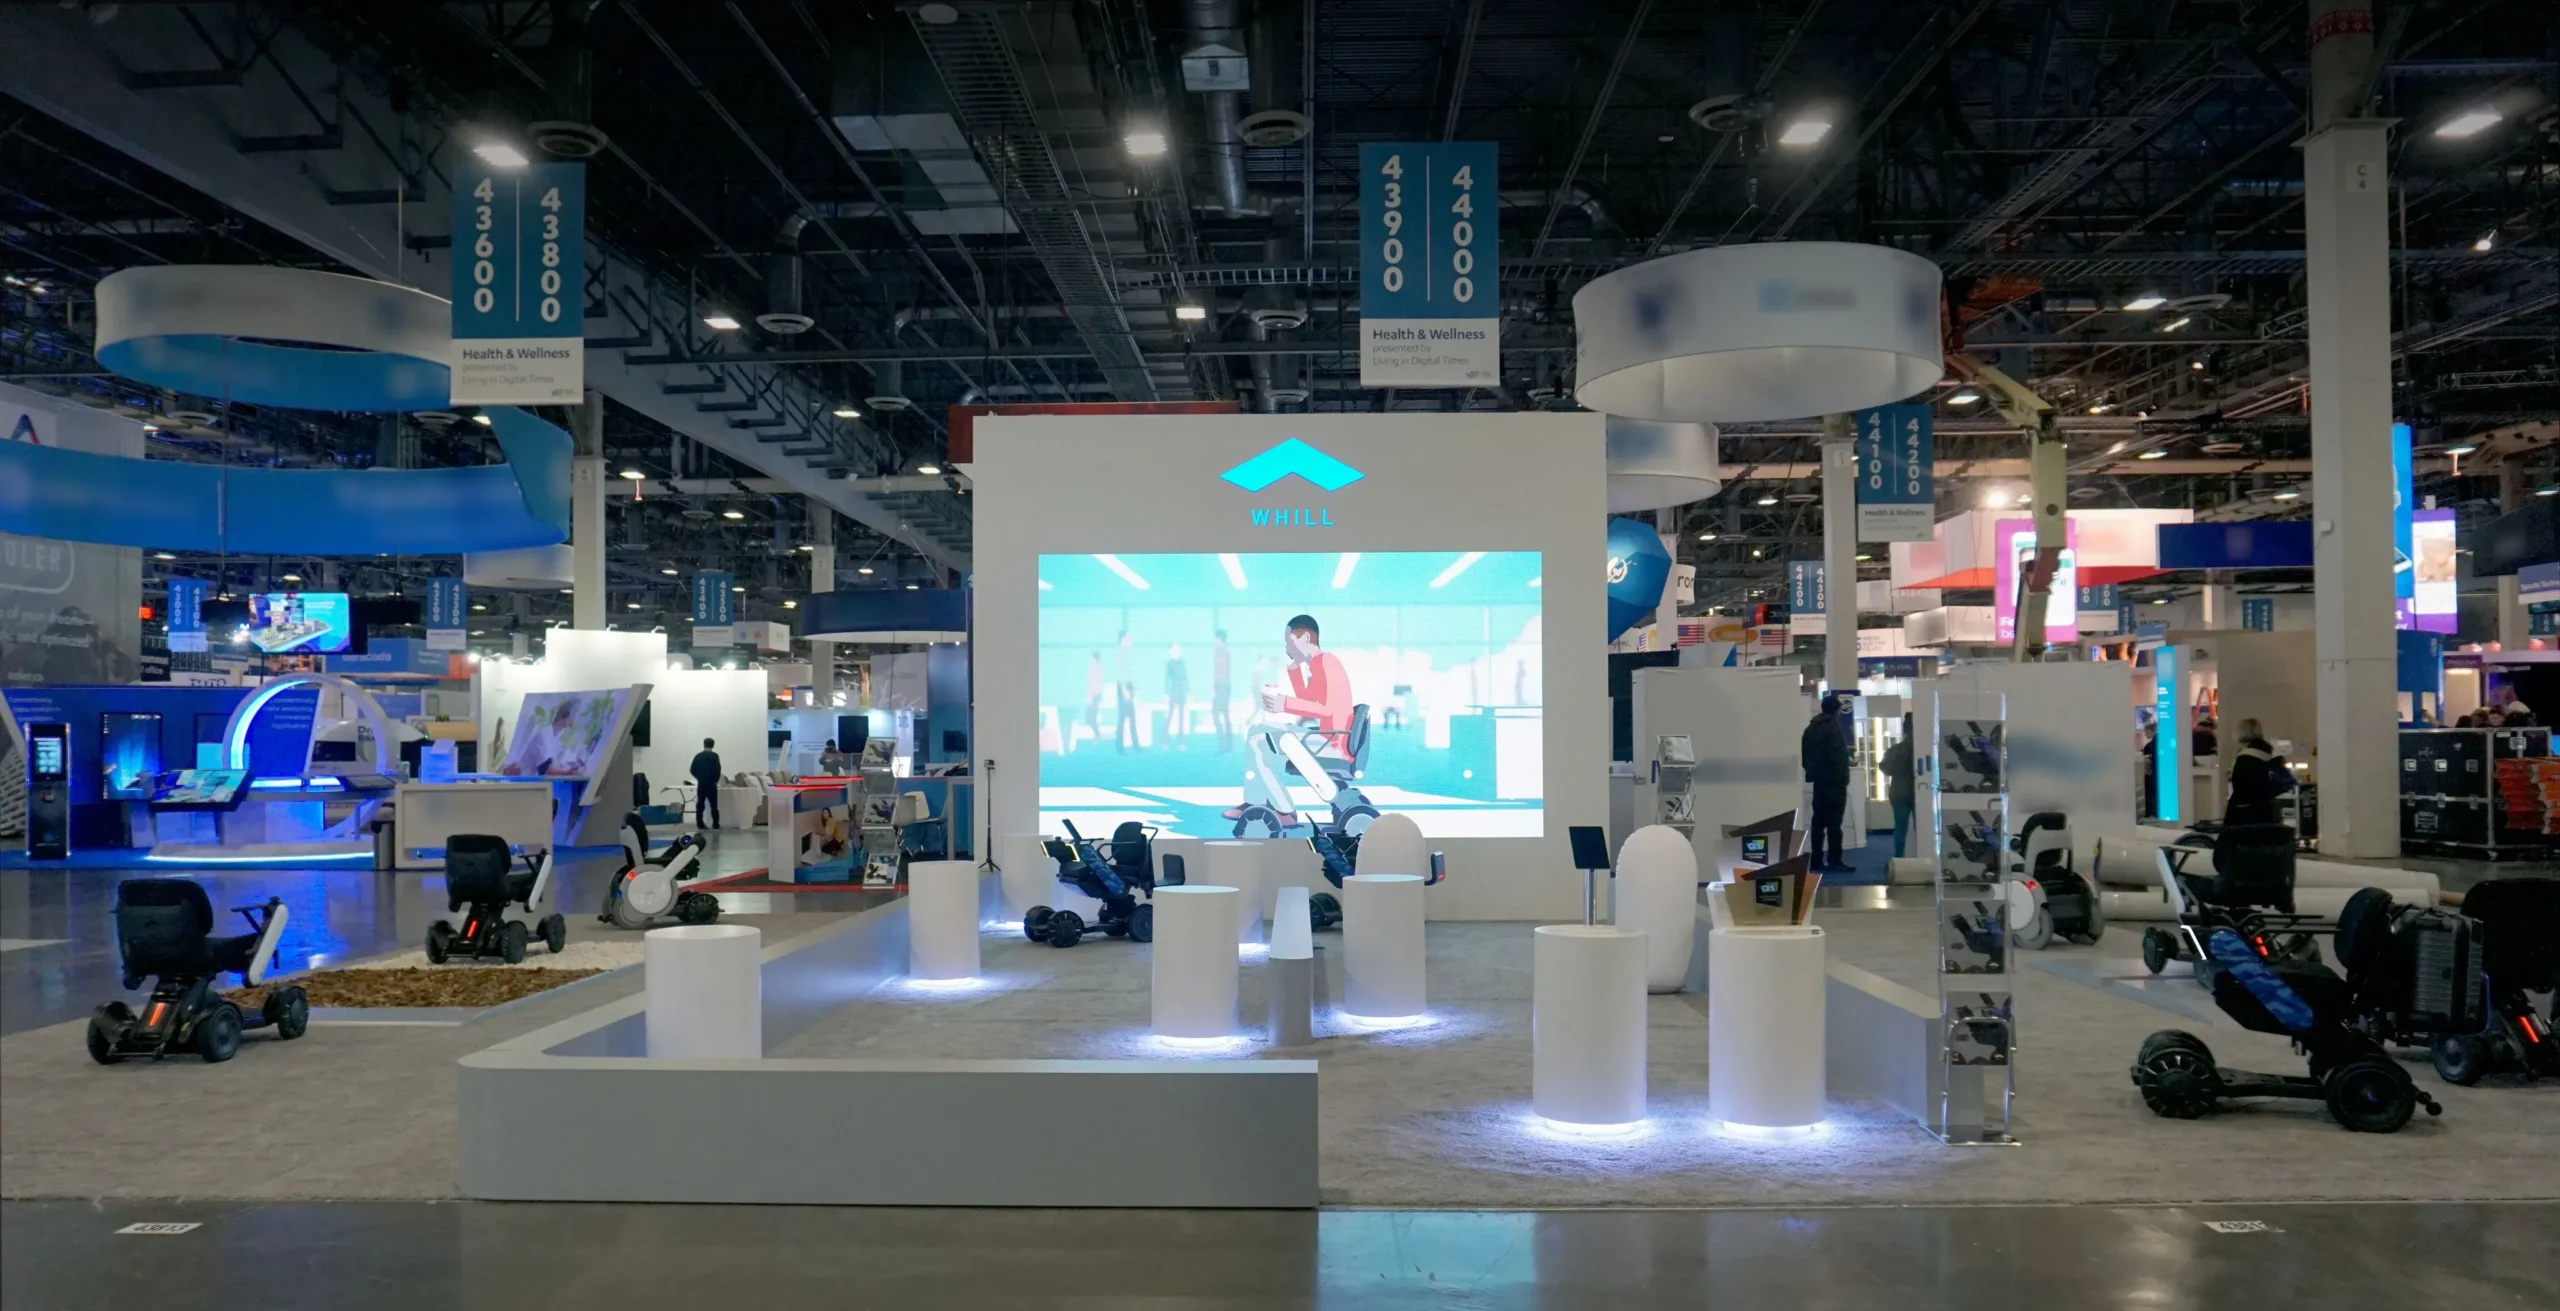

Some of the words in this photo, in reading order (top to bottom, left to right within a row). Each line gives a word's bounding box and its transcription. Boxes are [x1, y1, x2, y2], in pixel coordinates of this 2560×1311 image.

[1381, 154, 1404, 293] 43900
[1452, 164, 1474, 303] 44000
[474, 177, 494, 313] 43600
[540, 186, 562, 322] 43800
[463, 347, 504, 360] Health
[506, 348, 515, 360] &
[517, 347, 570, 360] Wellness
[1373, 328, 1415, 340] Health
[1417, 329, 1427, 340] &
[1429, 328, 1485, 340] Wellness
[1373, 344, 1419, 355] presented
[1420, 343, 1431, 355] by
[1373, 356, 1399, 368] Living
[1401, 357, 1409, 365] in
[1411, 356, 1441, 368] Digital
[1442, 356, 1469, 366] Times
[1868, 412, 1882, 490] 44100
[1906, 417, 1920, 495] 44200
[1250, 507, 1336, 527] WHILL
[699, 577, 707, 619] 43400
[1795, 564, 1804, 607] 44200
[1816, 567, 1825, 609] 44300
